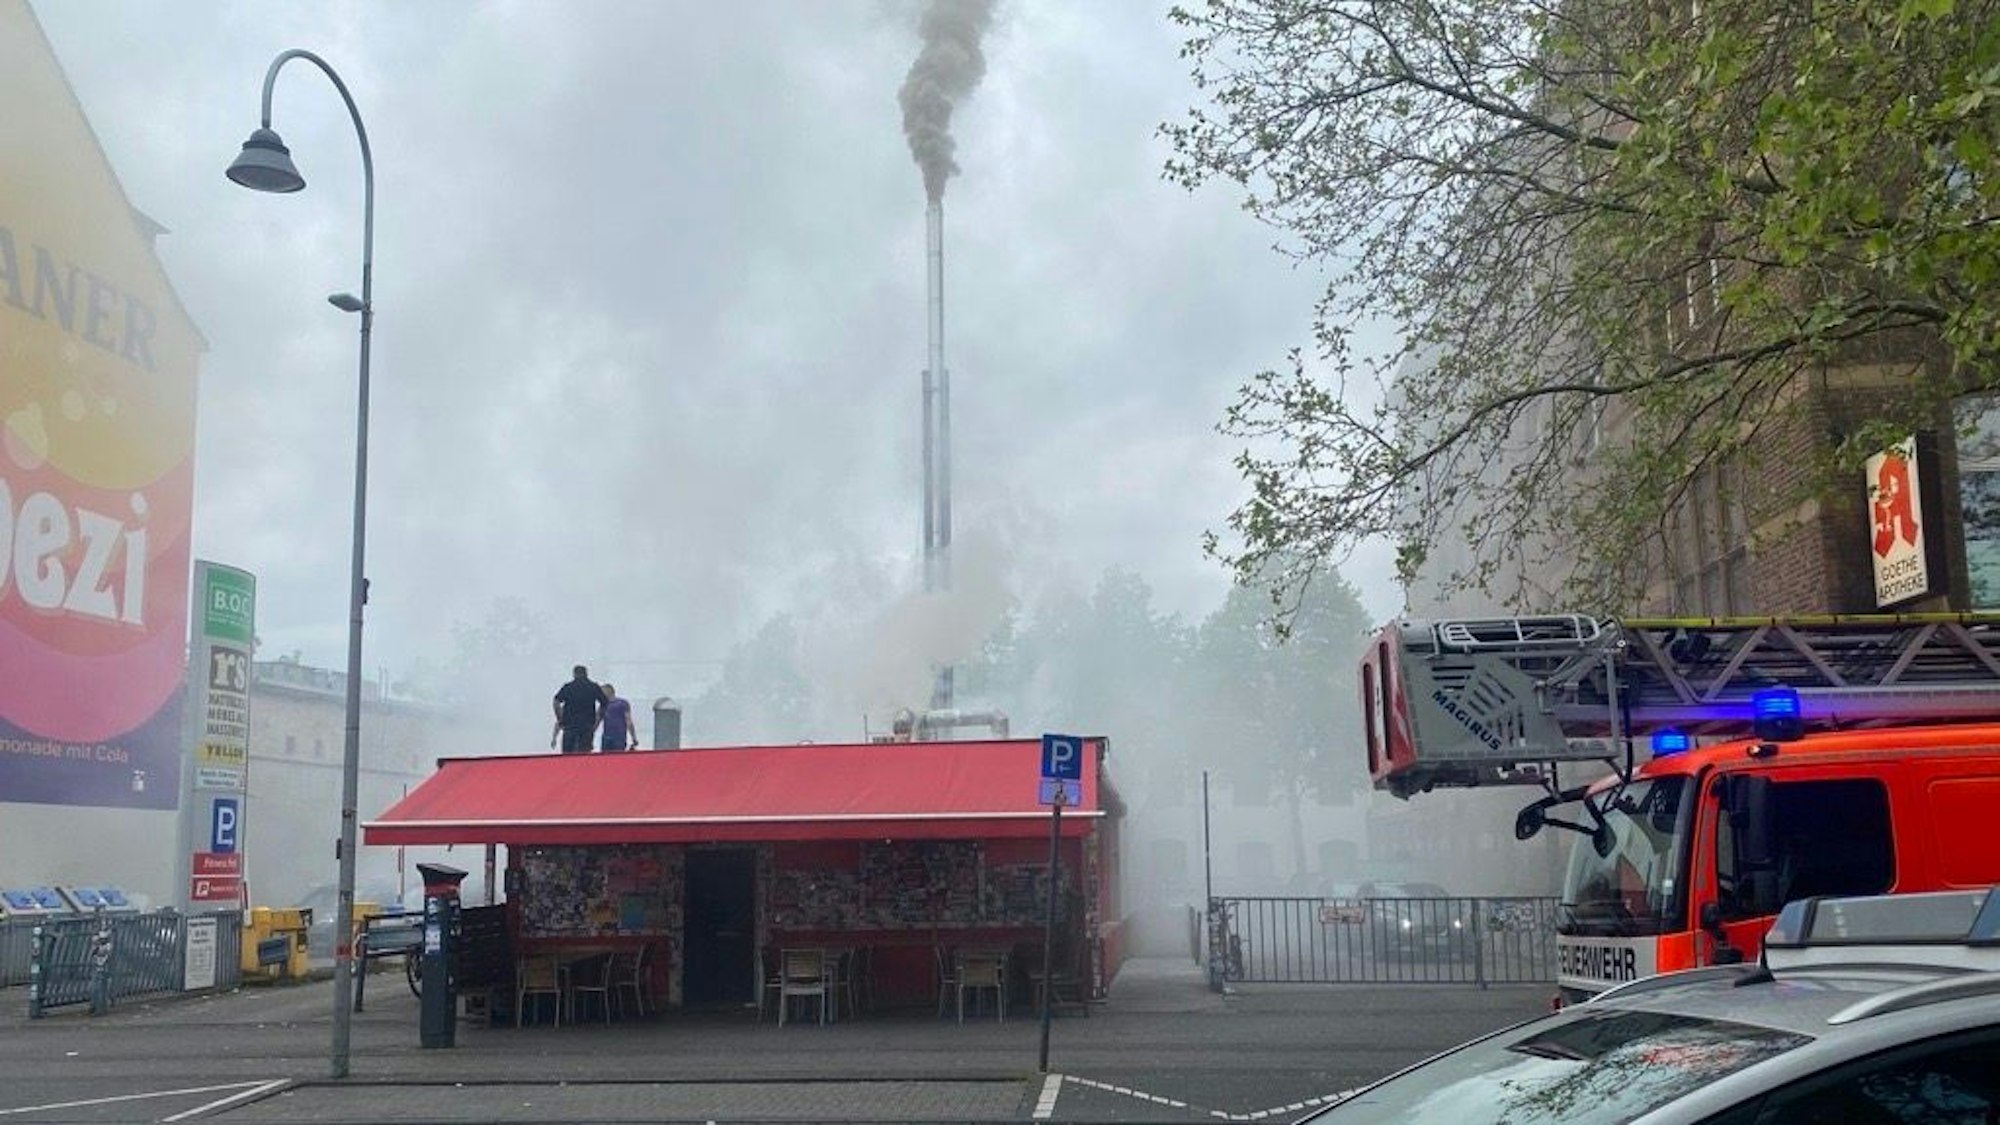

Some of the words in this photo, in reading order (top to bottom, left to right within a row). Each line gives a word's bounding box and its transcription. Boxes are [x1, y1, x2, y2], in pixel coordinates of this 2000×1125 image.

[1881, 554, 1919, 582] GOETHE
[1879, 572, 1924, 599] APOTHEKE
[214, 653, 246, 690] rs
[1432, 690, 1502, 751] MAGIRUS
[66, 743, 91, 761] mit
[96, 744, 129, 763] Cola
[1050, 741, 1074, 773] P
